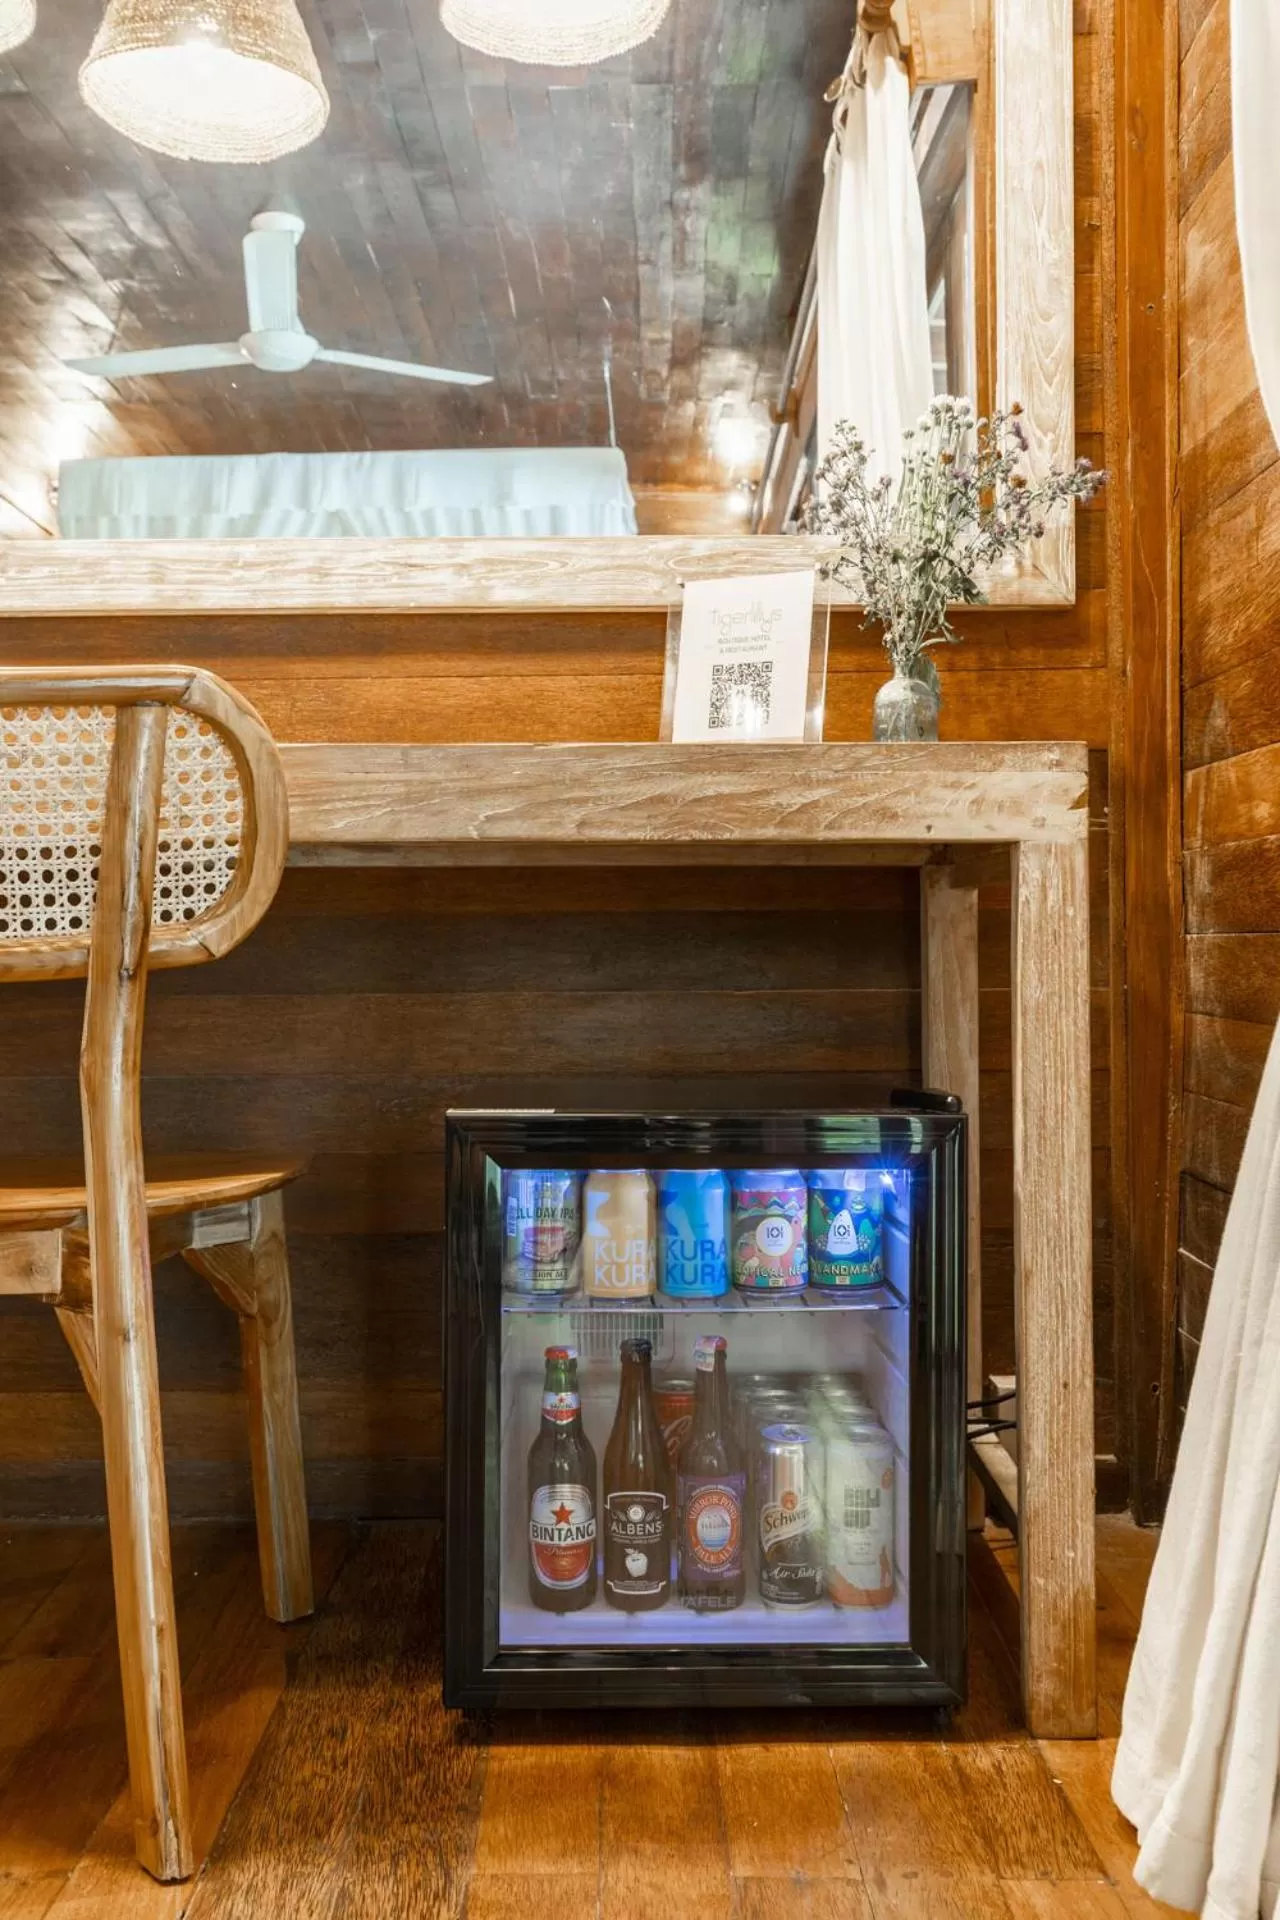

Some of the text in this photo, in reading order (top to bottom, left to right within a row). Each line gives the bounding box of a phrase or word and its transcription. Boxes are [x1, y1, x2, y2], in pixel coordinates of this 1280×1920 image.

[535, 1207, 556, 1219] DAY
[666, 1238, 728, 1261] KURA
[666, 1263, 728, 1286] KURA
[531, 1521, 594, 1544] BINTANG
[611, 1520, 662, 1536] ALBENS
